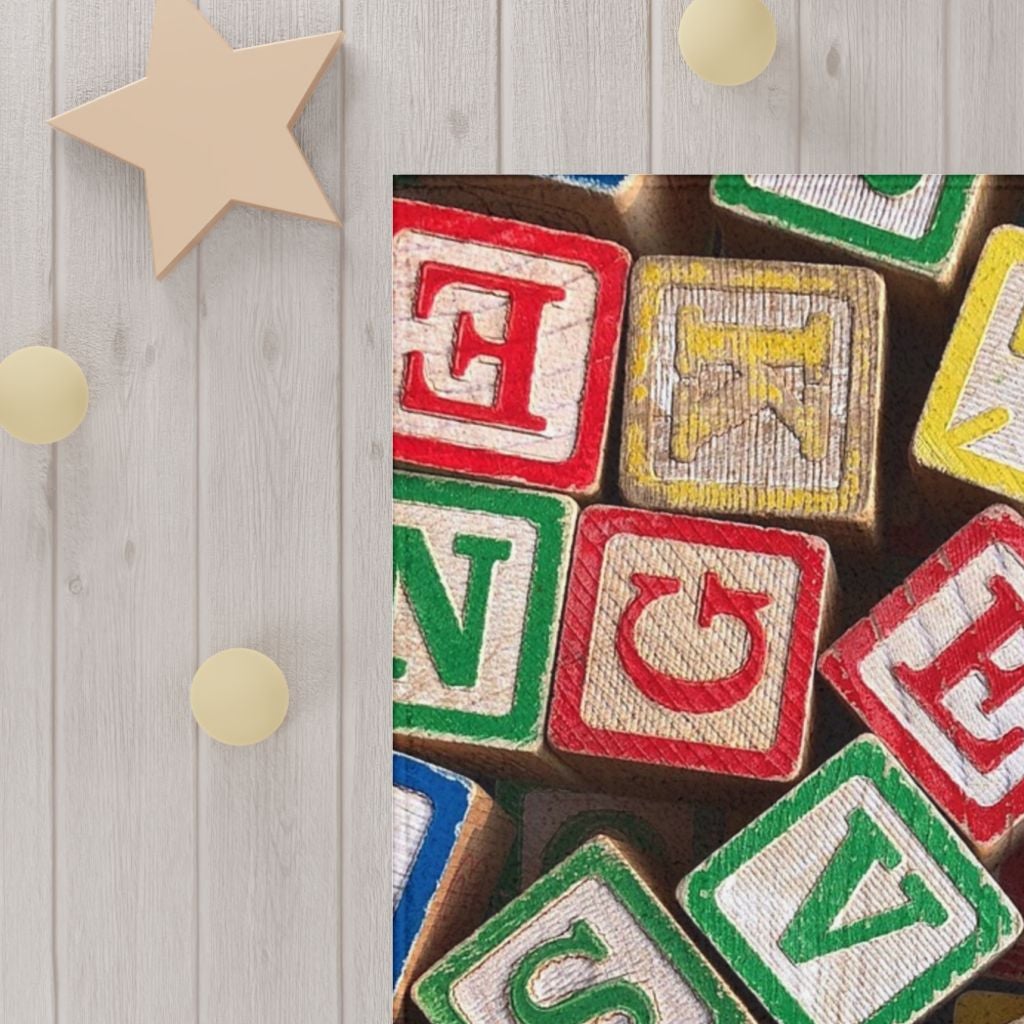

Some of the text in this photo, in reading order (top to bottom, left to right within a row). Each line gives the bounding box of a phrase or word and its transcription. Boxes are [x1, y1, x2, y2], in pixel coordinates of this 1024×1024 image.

[401, 260, 567, 432] E
[669, 304, 834, 463] K
[393, 524, 511, 687] N
[614, 571, 774, 715] G
[776, 806, 950, 965] V
